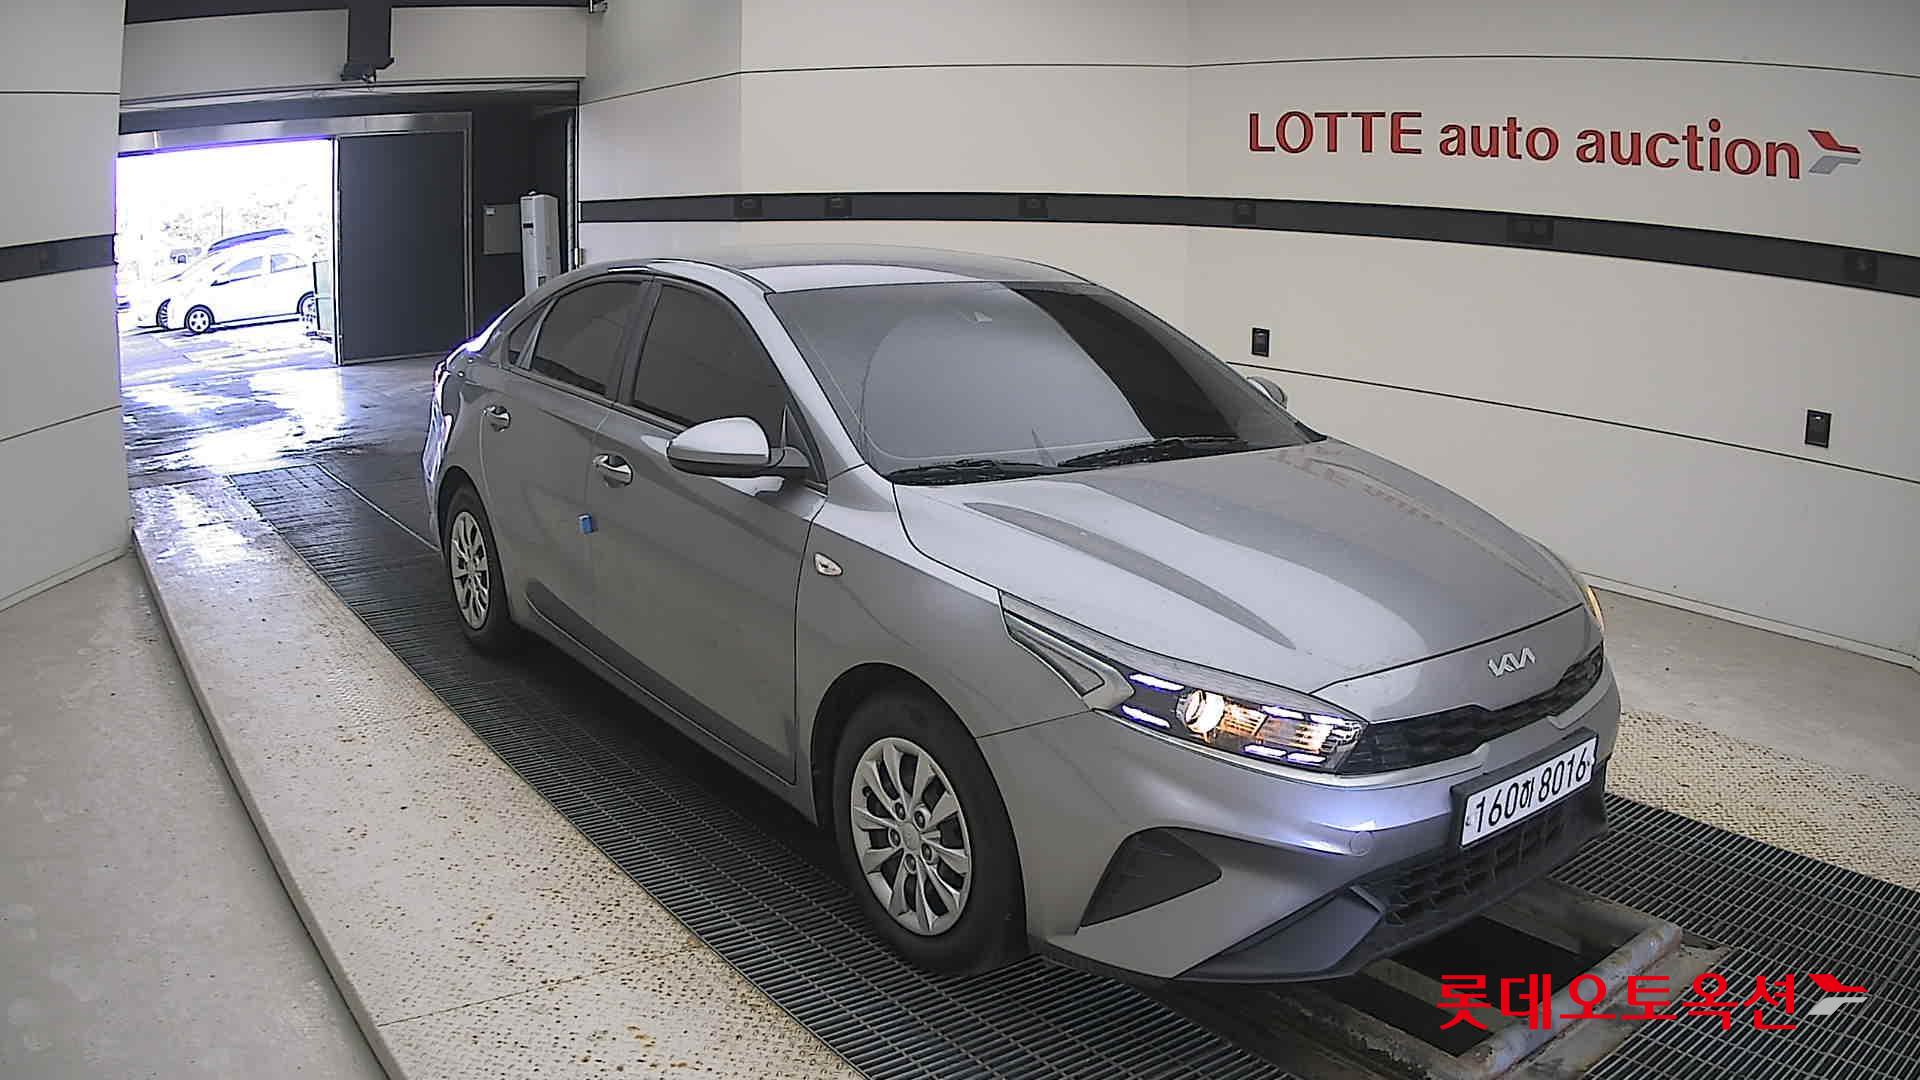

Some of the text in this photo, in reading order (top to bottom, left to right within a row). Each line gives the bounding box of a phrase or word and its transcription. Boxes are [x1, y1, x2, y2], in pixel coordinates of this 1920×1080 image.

[1248, 111, 1802, 180] LOTTE auto auction
[1538, 747, 1588, 803] 8016
